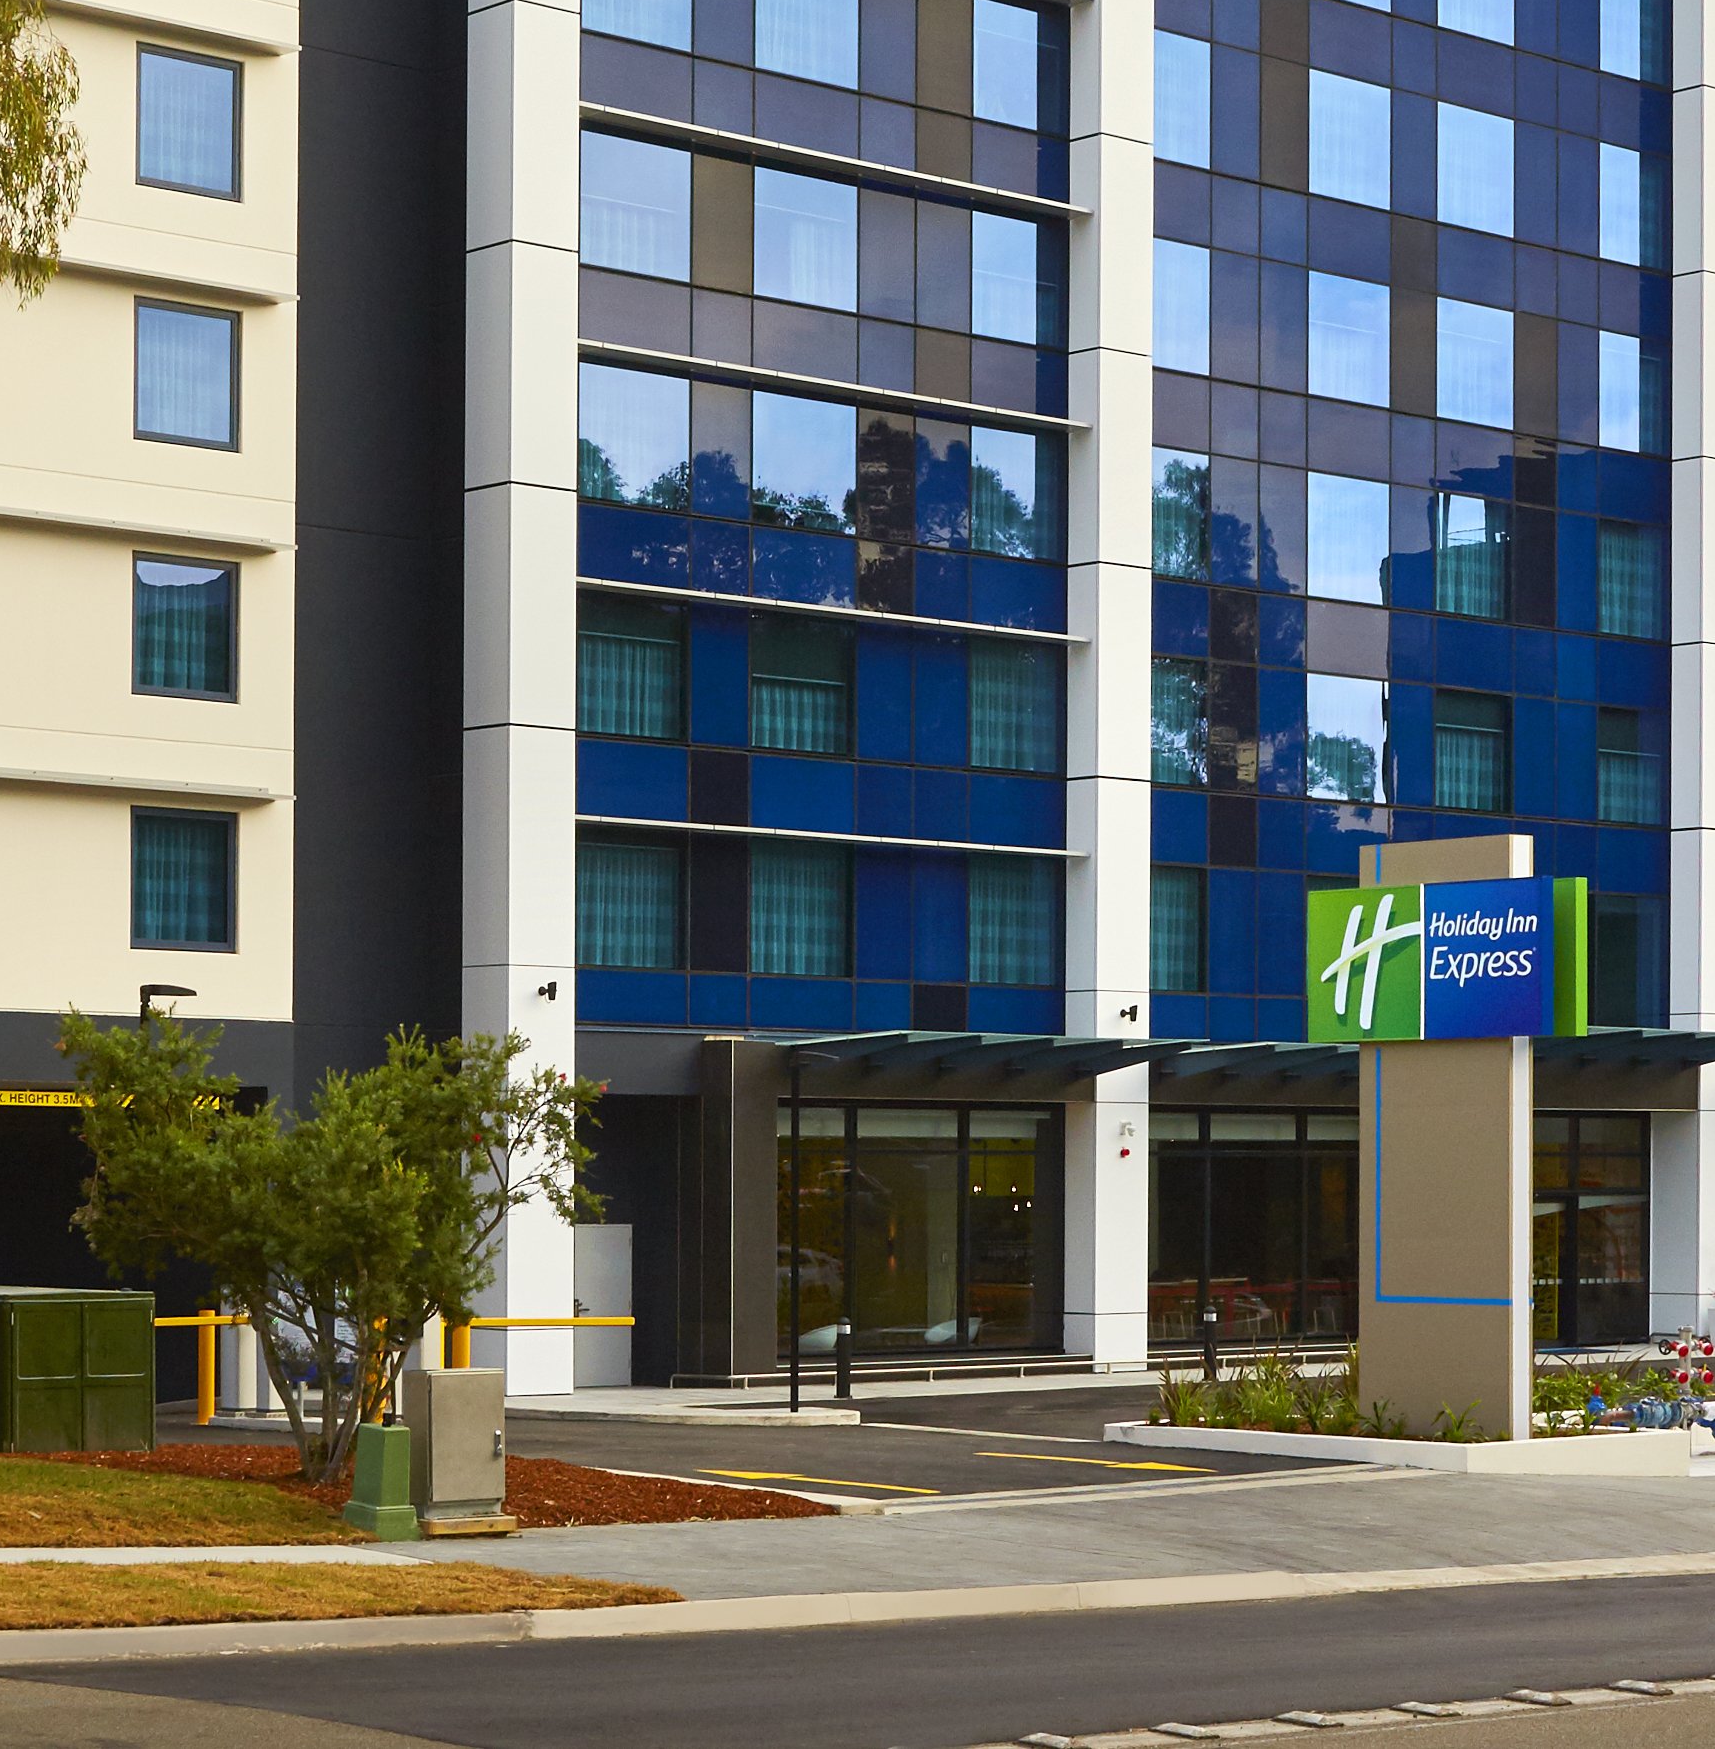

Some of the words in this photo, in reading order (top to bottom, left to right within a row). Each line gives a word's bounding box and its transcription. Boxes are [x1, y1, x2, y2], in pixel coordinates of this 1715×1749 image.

[1429, 910, 1503, 941] Holiday
[1506, 907, 1538, 934] Inn
[1429, 946, 1533, 988] Express
[9, 1093, 51, 1104] HEIGHT
